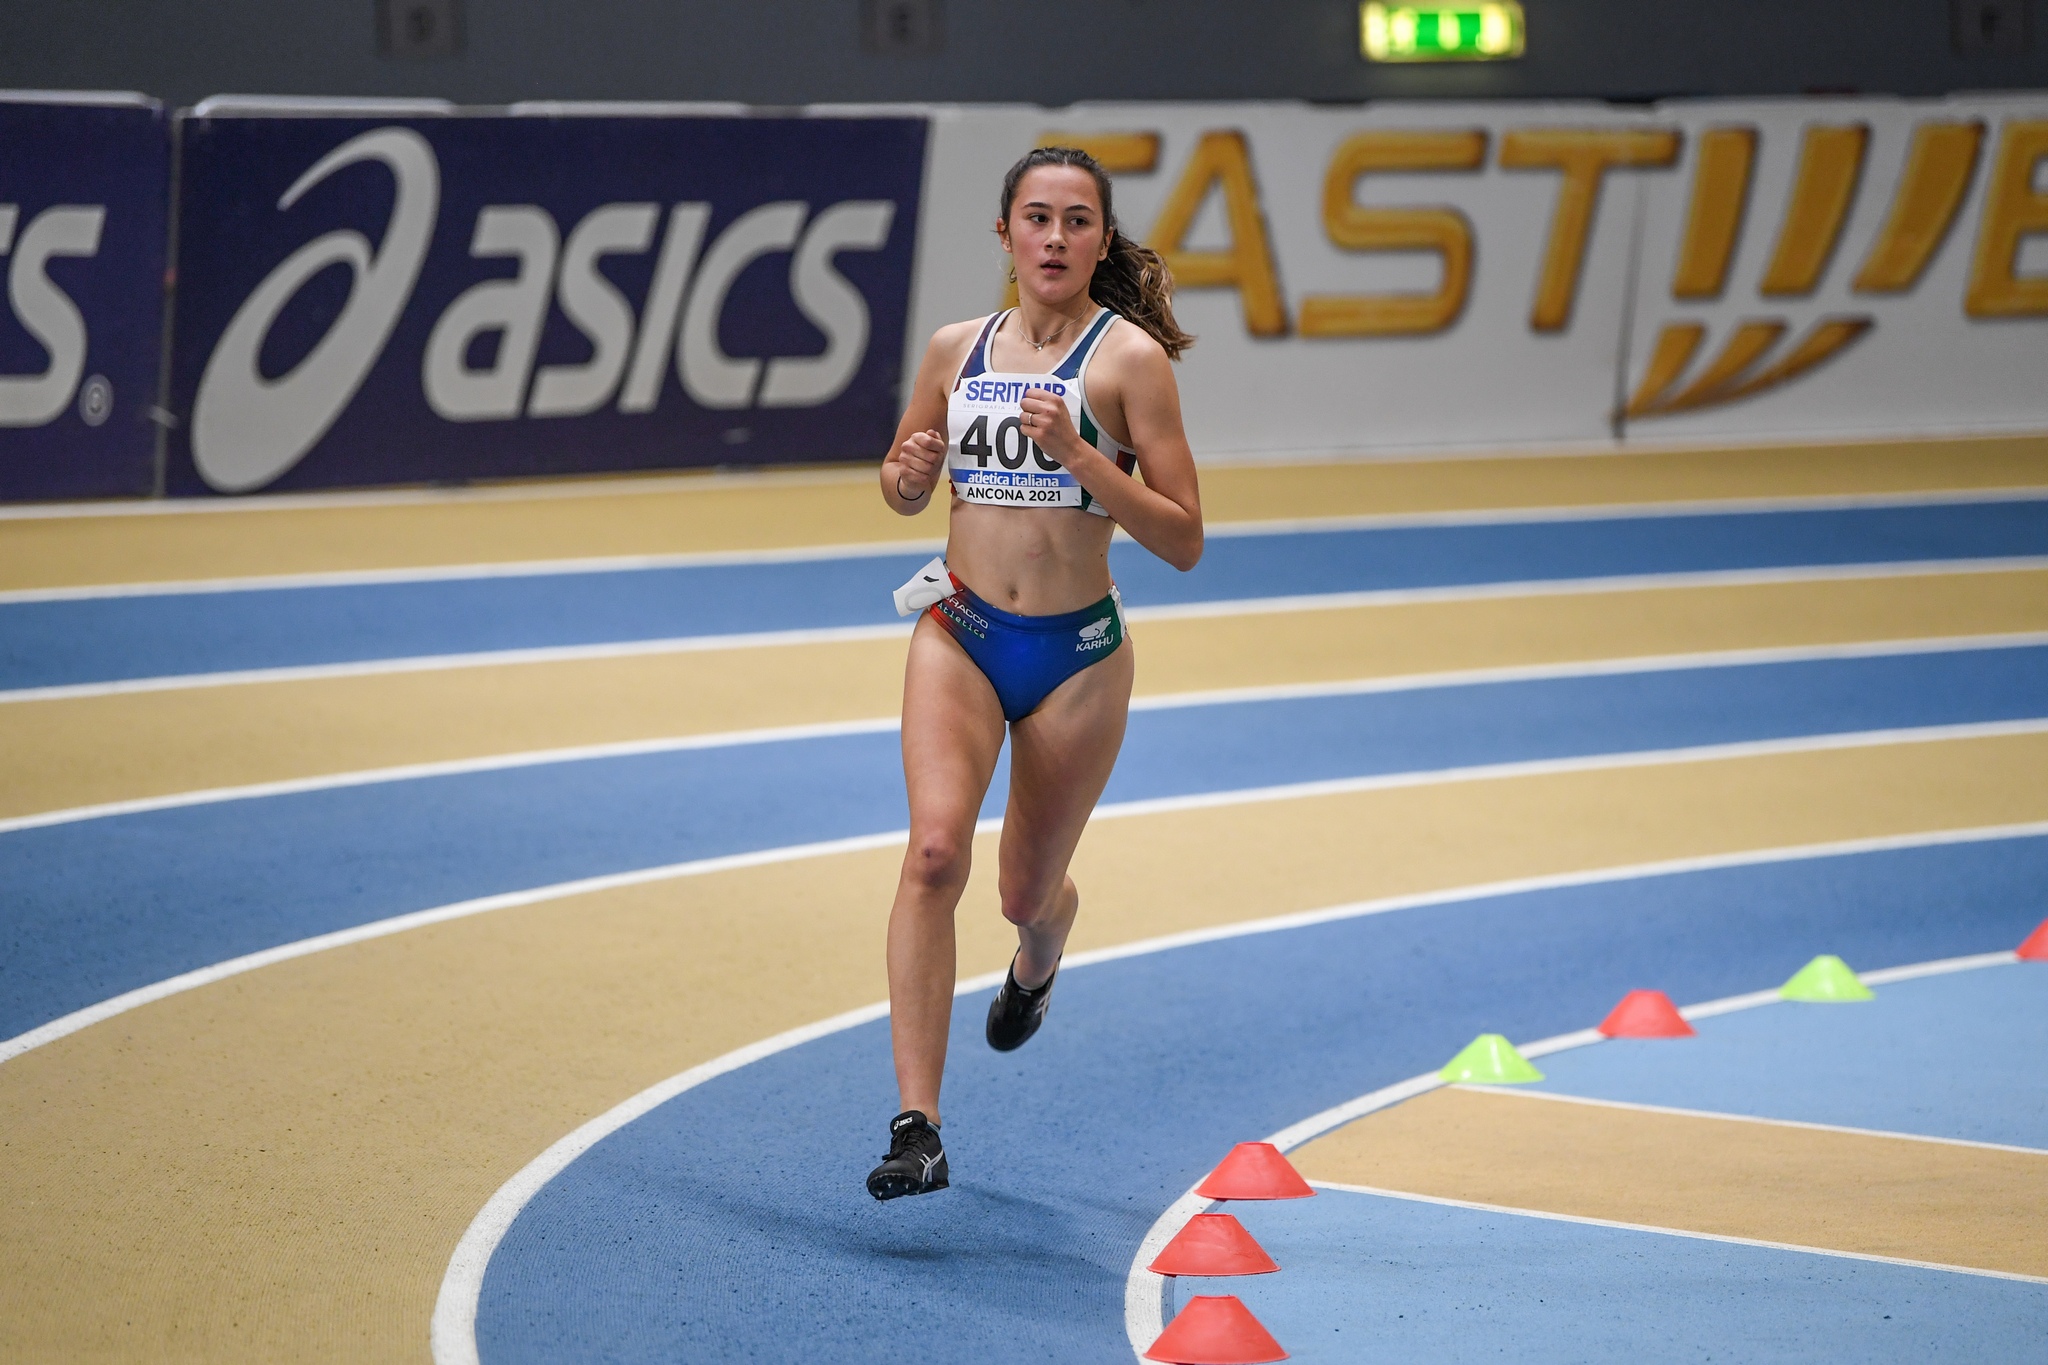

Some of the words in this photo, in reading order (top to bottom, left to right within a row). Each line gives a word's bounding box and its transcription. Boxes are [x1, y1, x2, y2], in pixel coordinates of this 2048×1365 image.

[967, 470, 1009, 486] atletica
[1012, 473, 1059, 487] italiana
[967, 487, 1025, 501] ANCONA
[1028, 490, 1061, 502] 2021
[937, 602, 986, 639] Atletica
[946, 596, 989, 630] RACCO
[1075, 634, 1114, 652] KARHU
